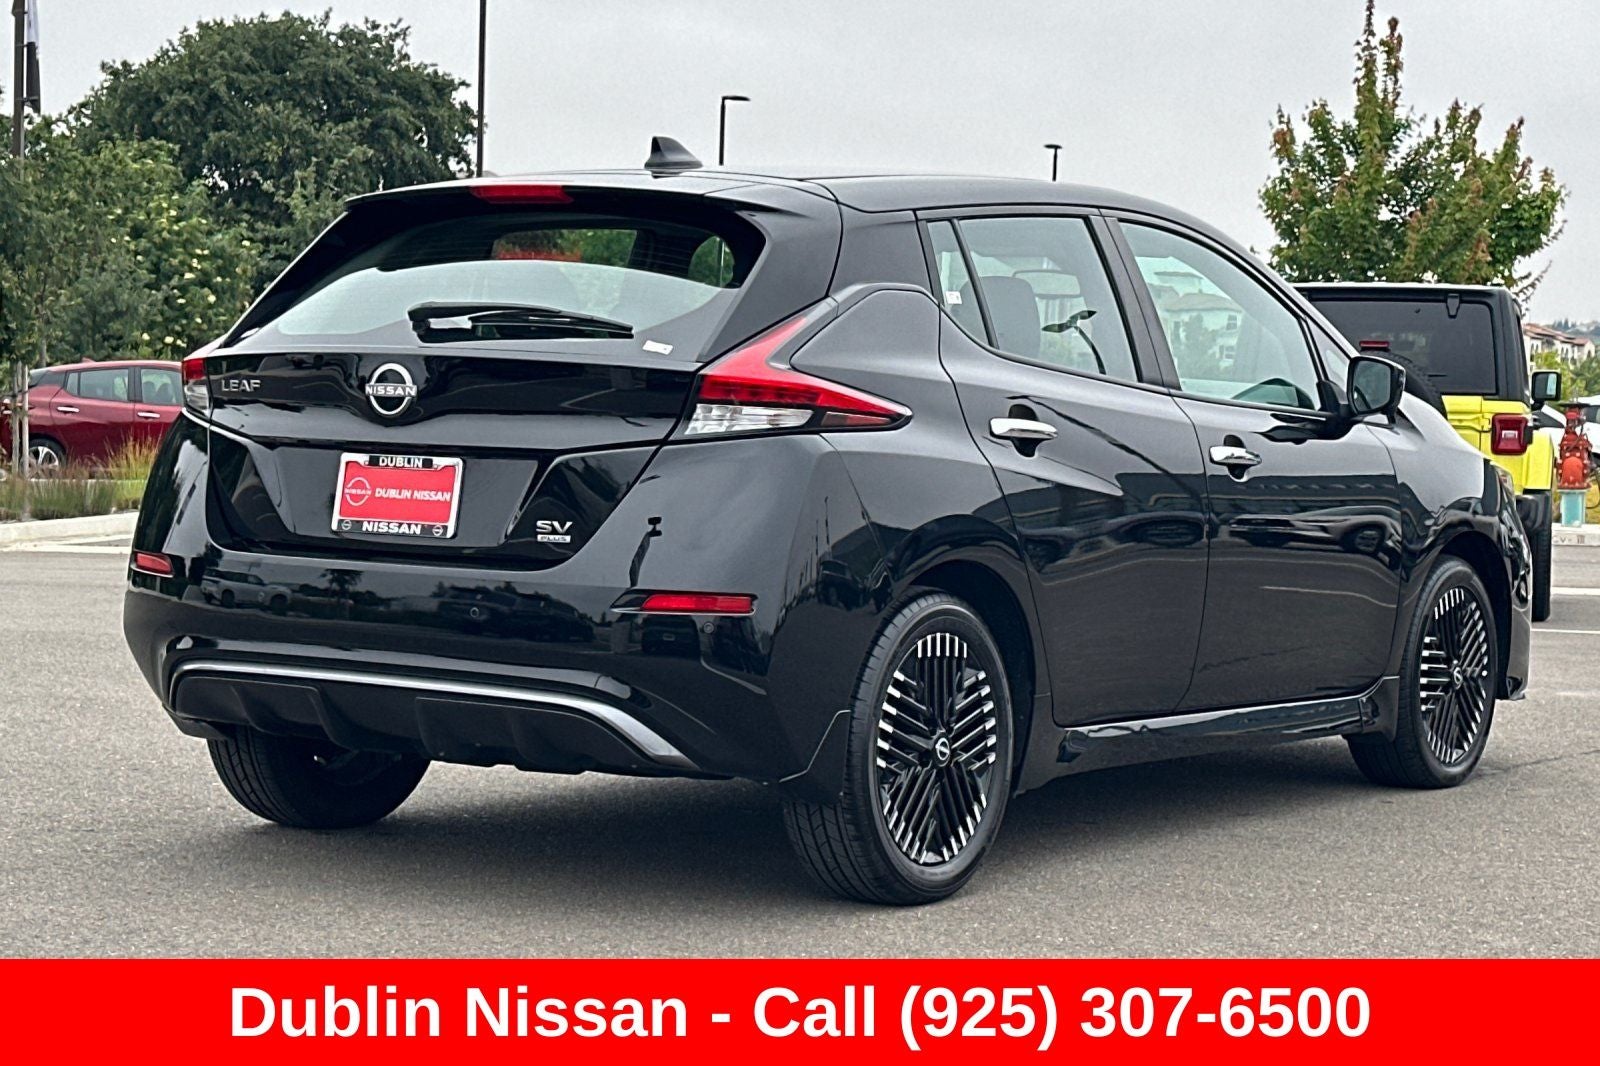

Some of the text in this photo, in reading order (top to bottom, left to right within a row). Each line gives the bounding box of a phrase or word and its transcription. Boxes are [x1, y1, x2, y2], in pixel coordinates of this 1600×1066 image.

[221, 379, 262, 392] LEAF
[365, 385, 416, 396] NISSAN
[379, 456, 423, 468] DUBLIN
[345, 487, 371, 495] NISSAN
[375, 487, 451, 502] DUBLIN NISSAN
[362, 521, 421, 535] NISSAN
[536, 520, 573, 534] SV
